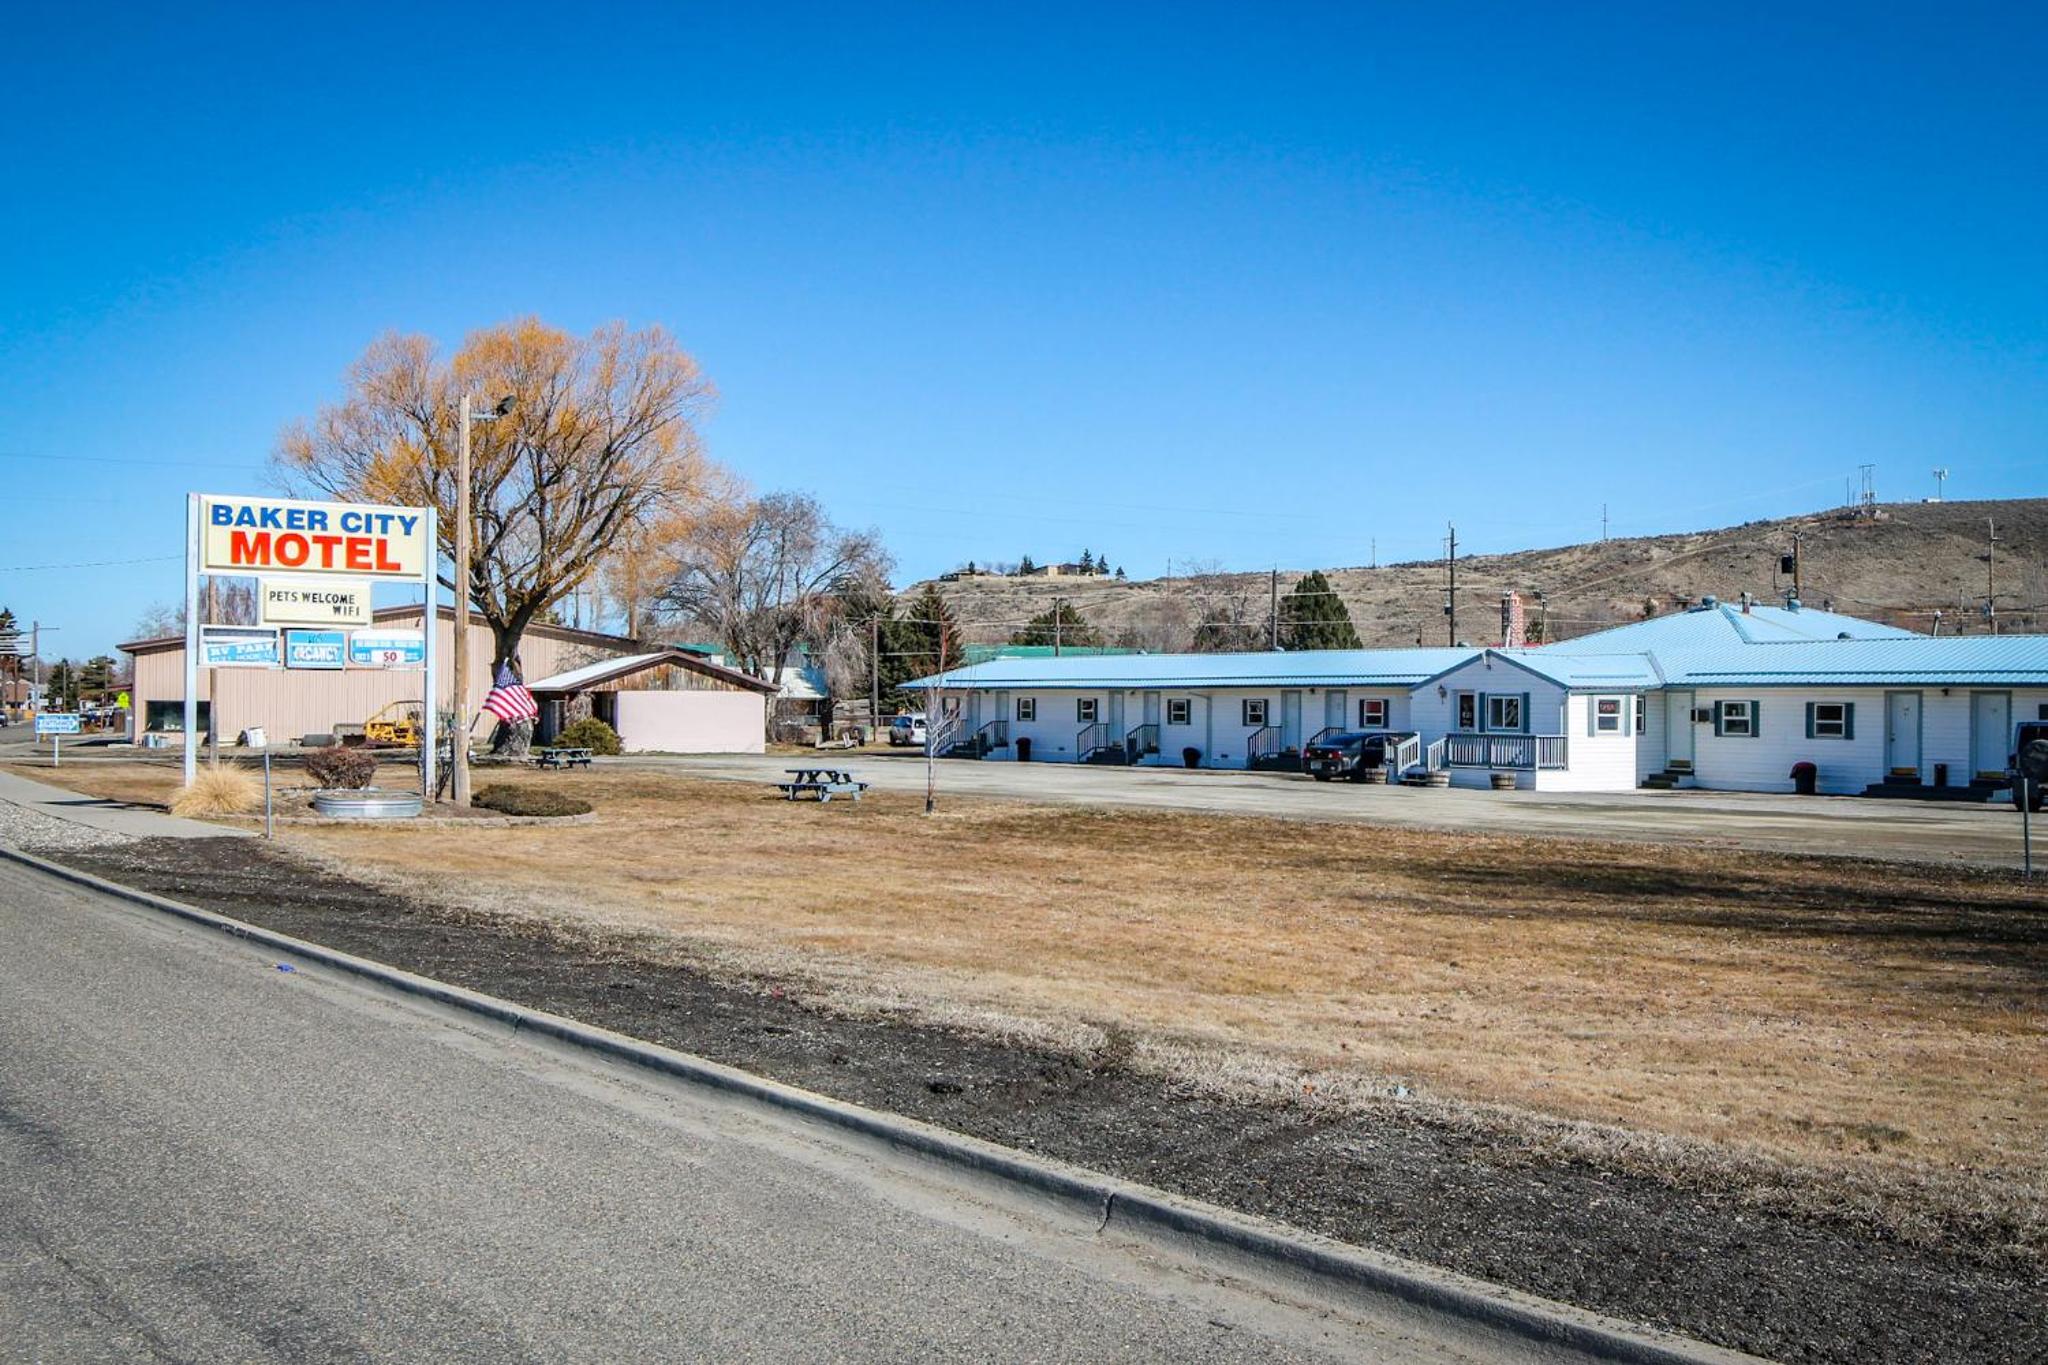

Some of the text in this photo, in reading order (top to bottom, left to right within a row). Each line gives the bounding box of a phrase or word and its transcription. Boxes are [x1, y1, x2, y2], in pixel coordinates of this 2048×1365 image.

[211, 504, 418, 536] BAKER CITY
[230, 530, 401, 571] MOTEL
[269, 590, 355, 605] PETS WELCOME
[332, 605, 360, 617] WIFI
[383, 651, 397, 662] 50
